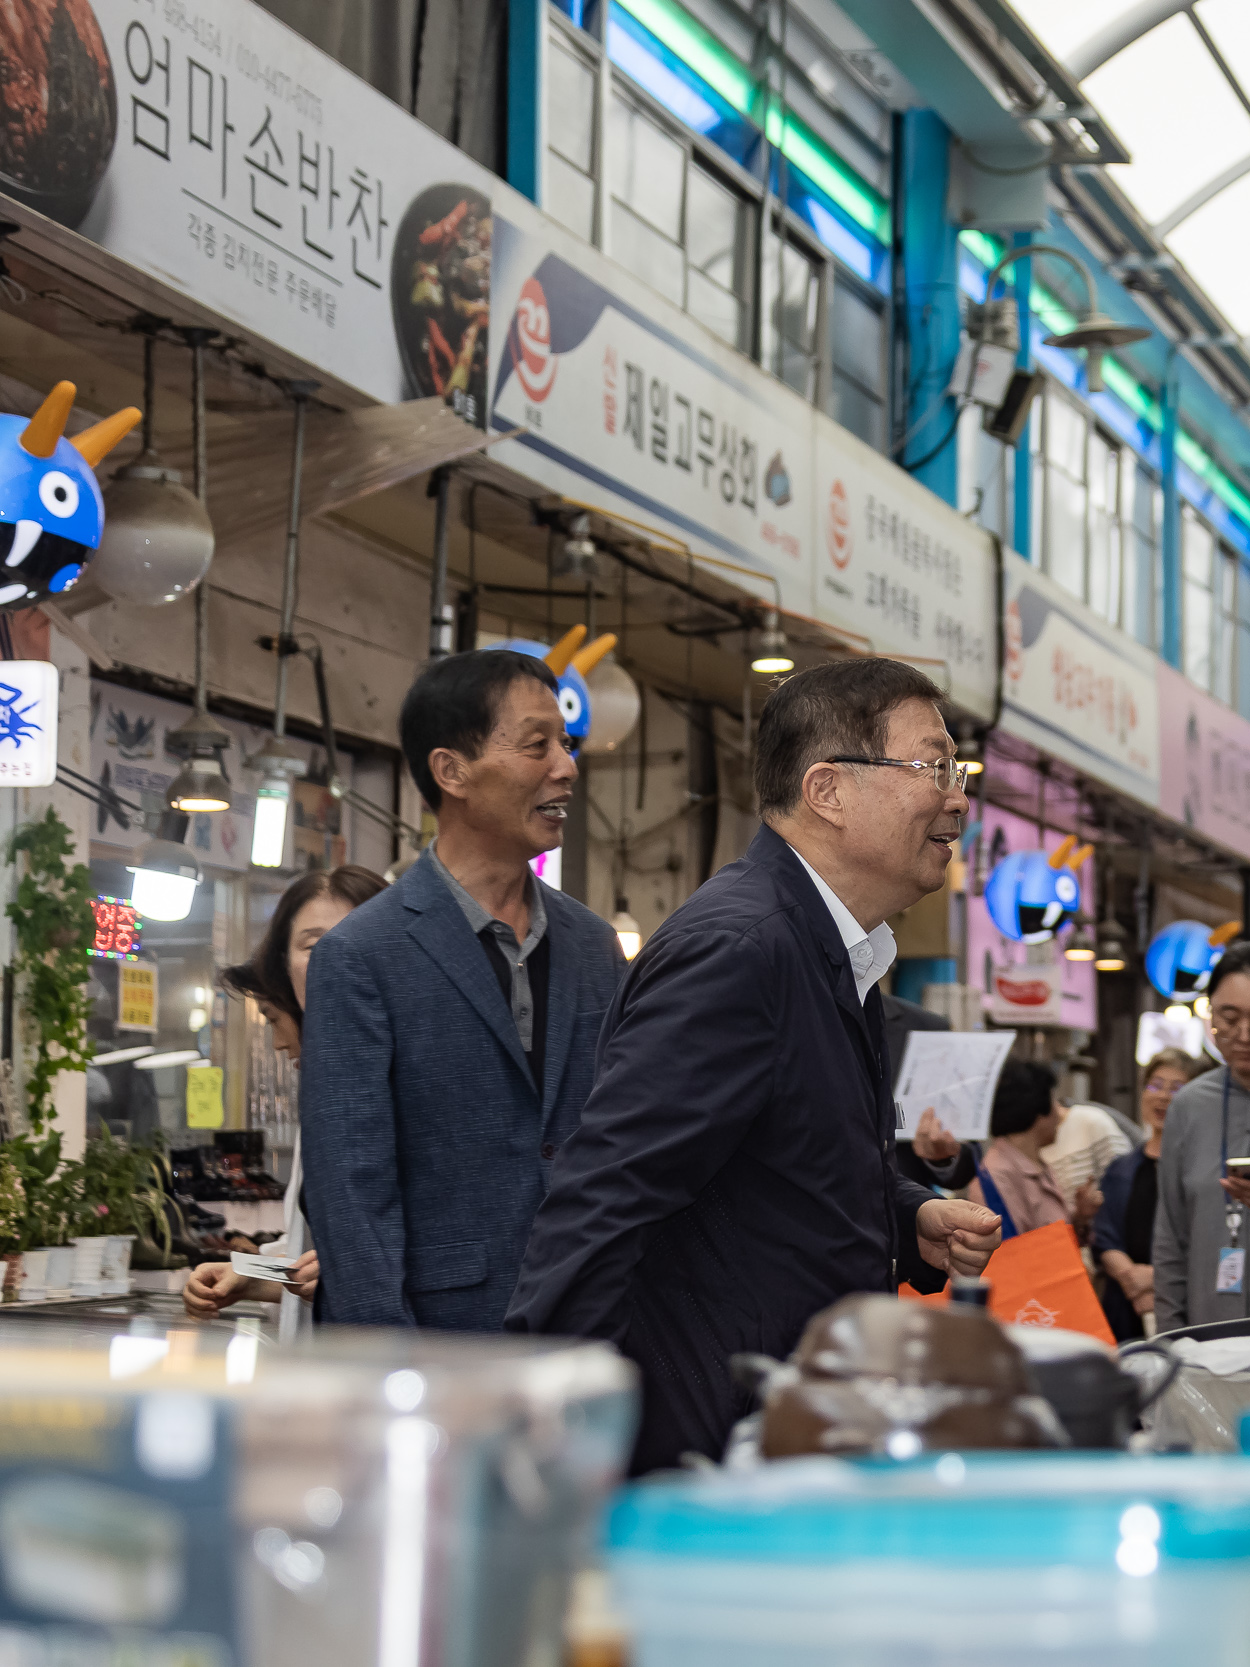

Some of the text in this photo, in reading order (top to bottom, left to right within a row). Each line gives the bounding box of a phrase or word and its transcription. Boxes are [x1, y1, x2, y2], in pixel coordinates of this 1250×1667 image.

[125, 19, 390, 290] 엄마손반찬
[187, 212, 217, 259] 각종
[622, 359, 760, 517] 제일고무상회
[90, 901, 136, 953] 업중
